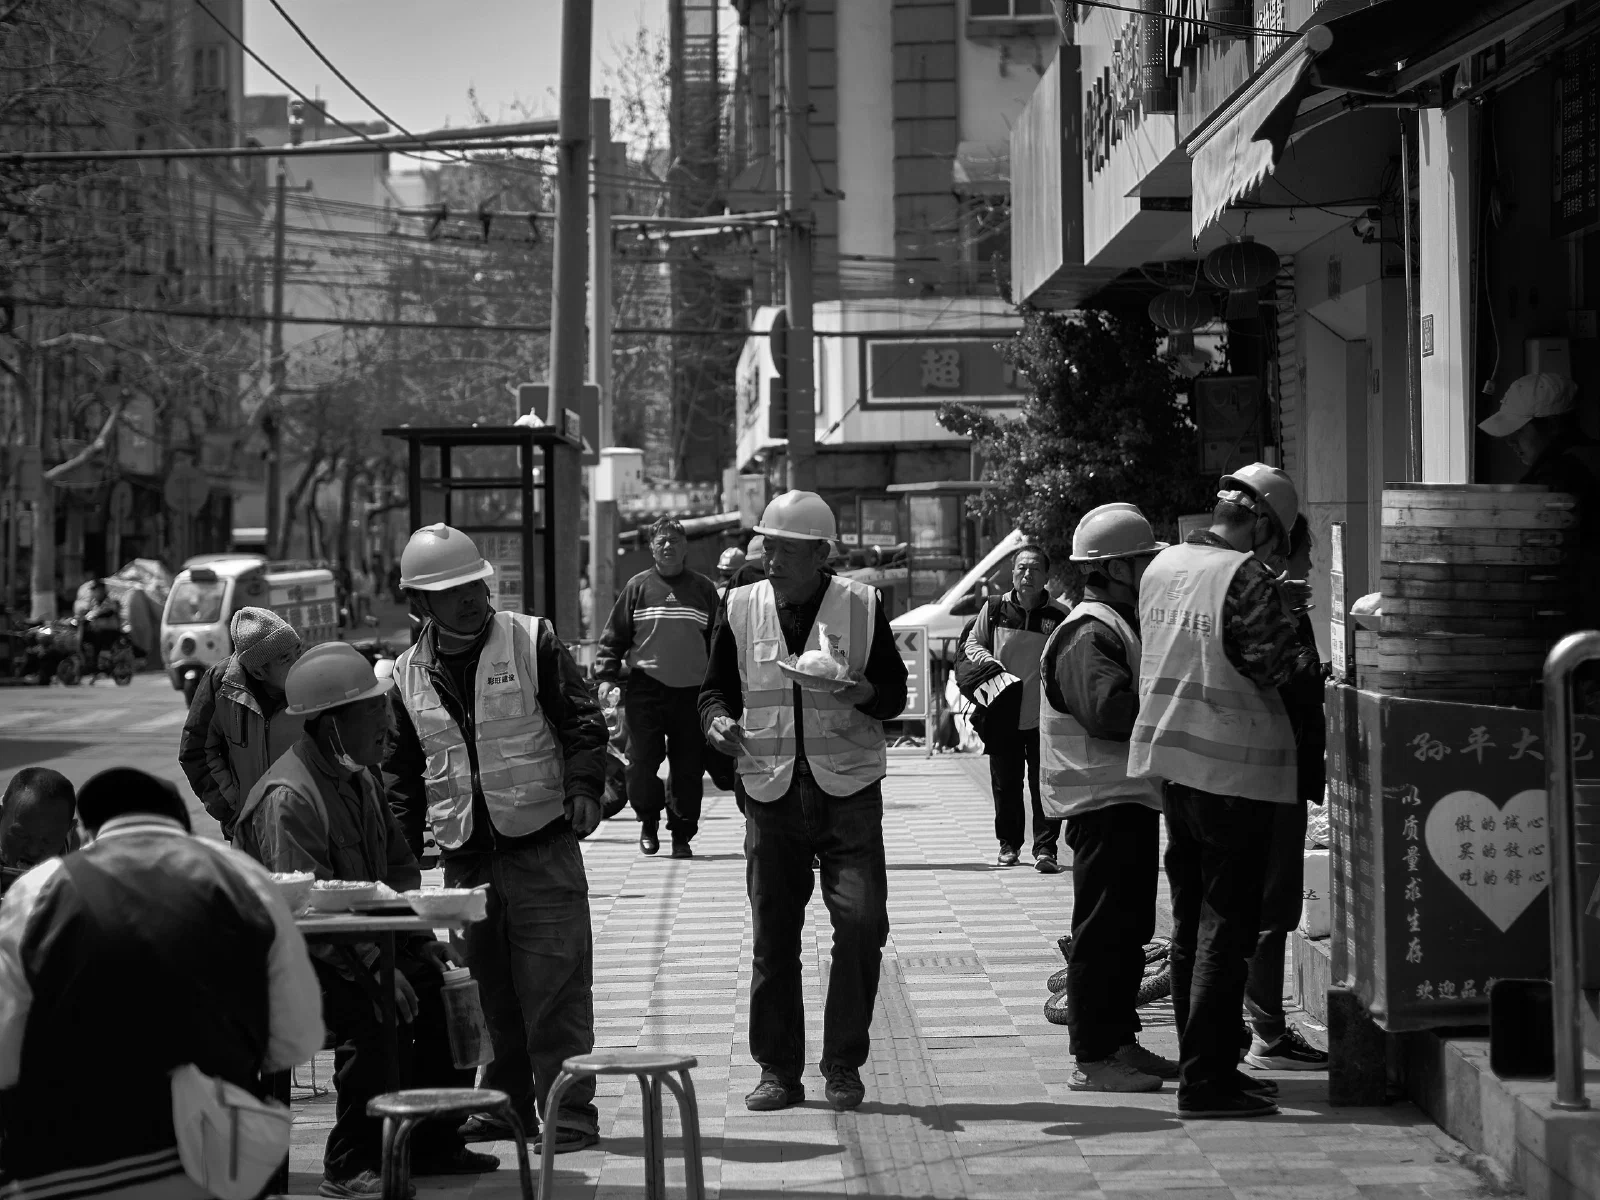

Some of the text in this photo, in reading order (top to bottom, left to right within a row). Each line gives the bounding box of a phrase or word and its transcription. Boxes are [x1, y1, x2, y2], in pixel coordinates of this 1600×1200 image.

[1454, 814, 1544, 833] 做的诚心
[1457, 842, 1546, 860] 买的放心
[1401, 783, 1423, 964] 以质量求生存
[1459, 868, 1546, 886] 吃的舒心
